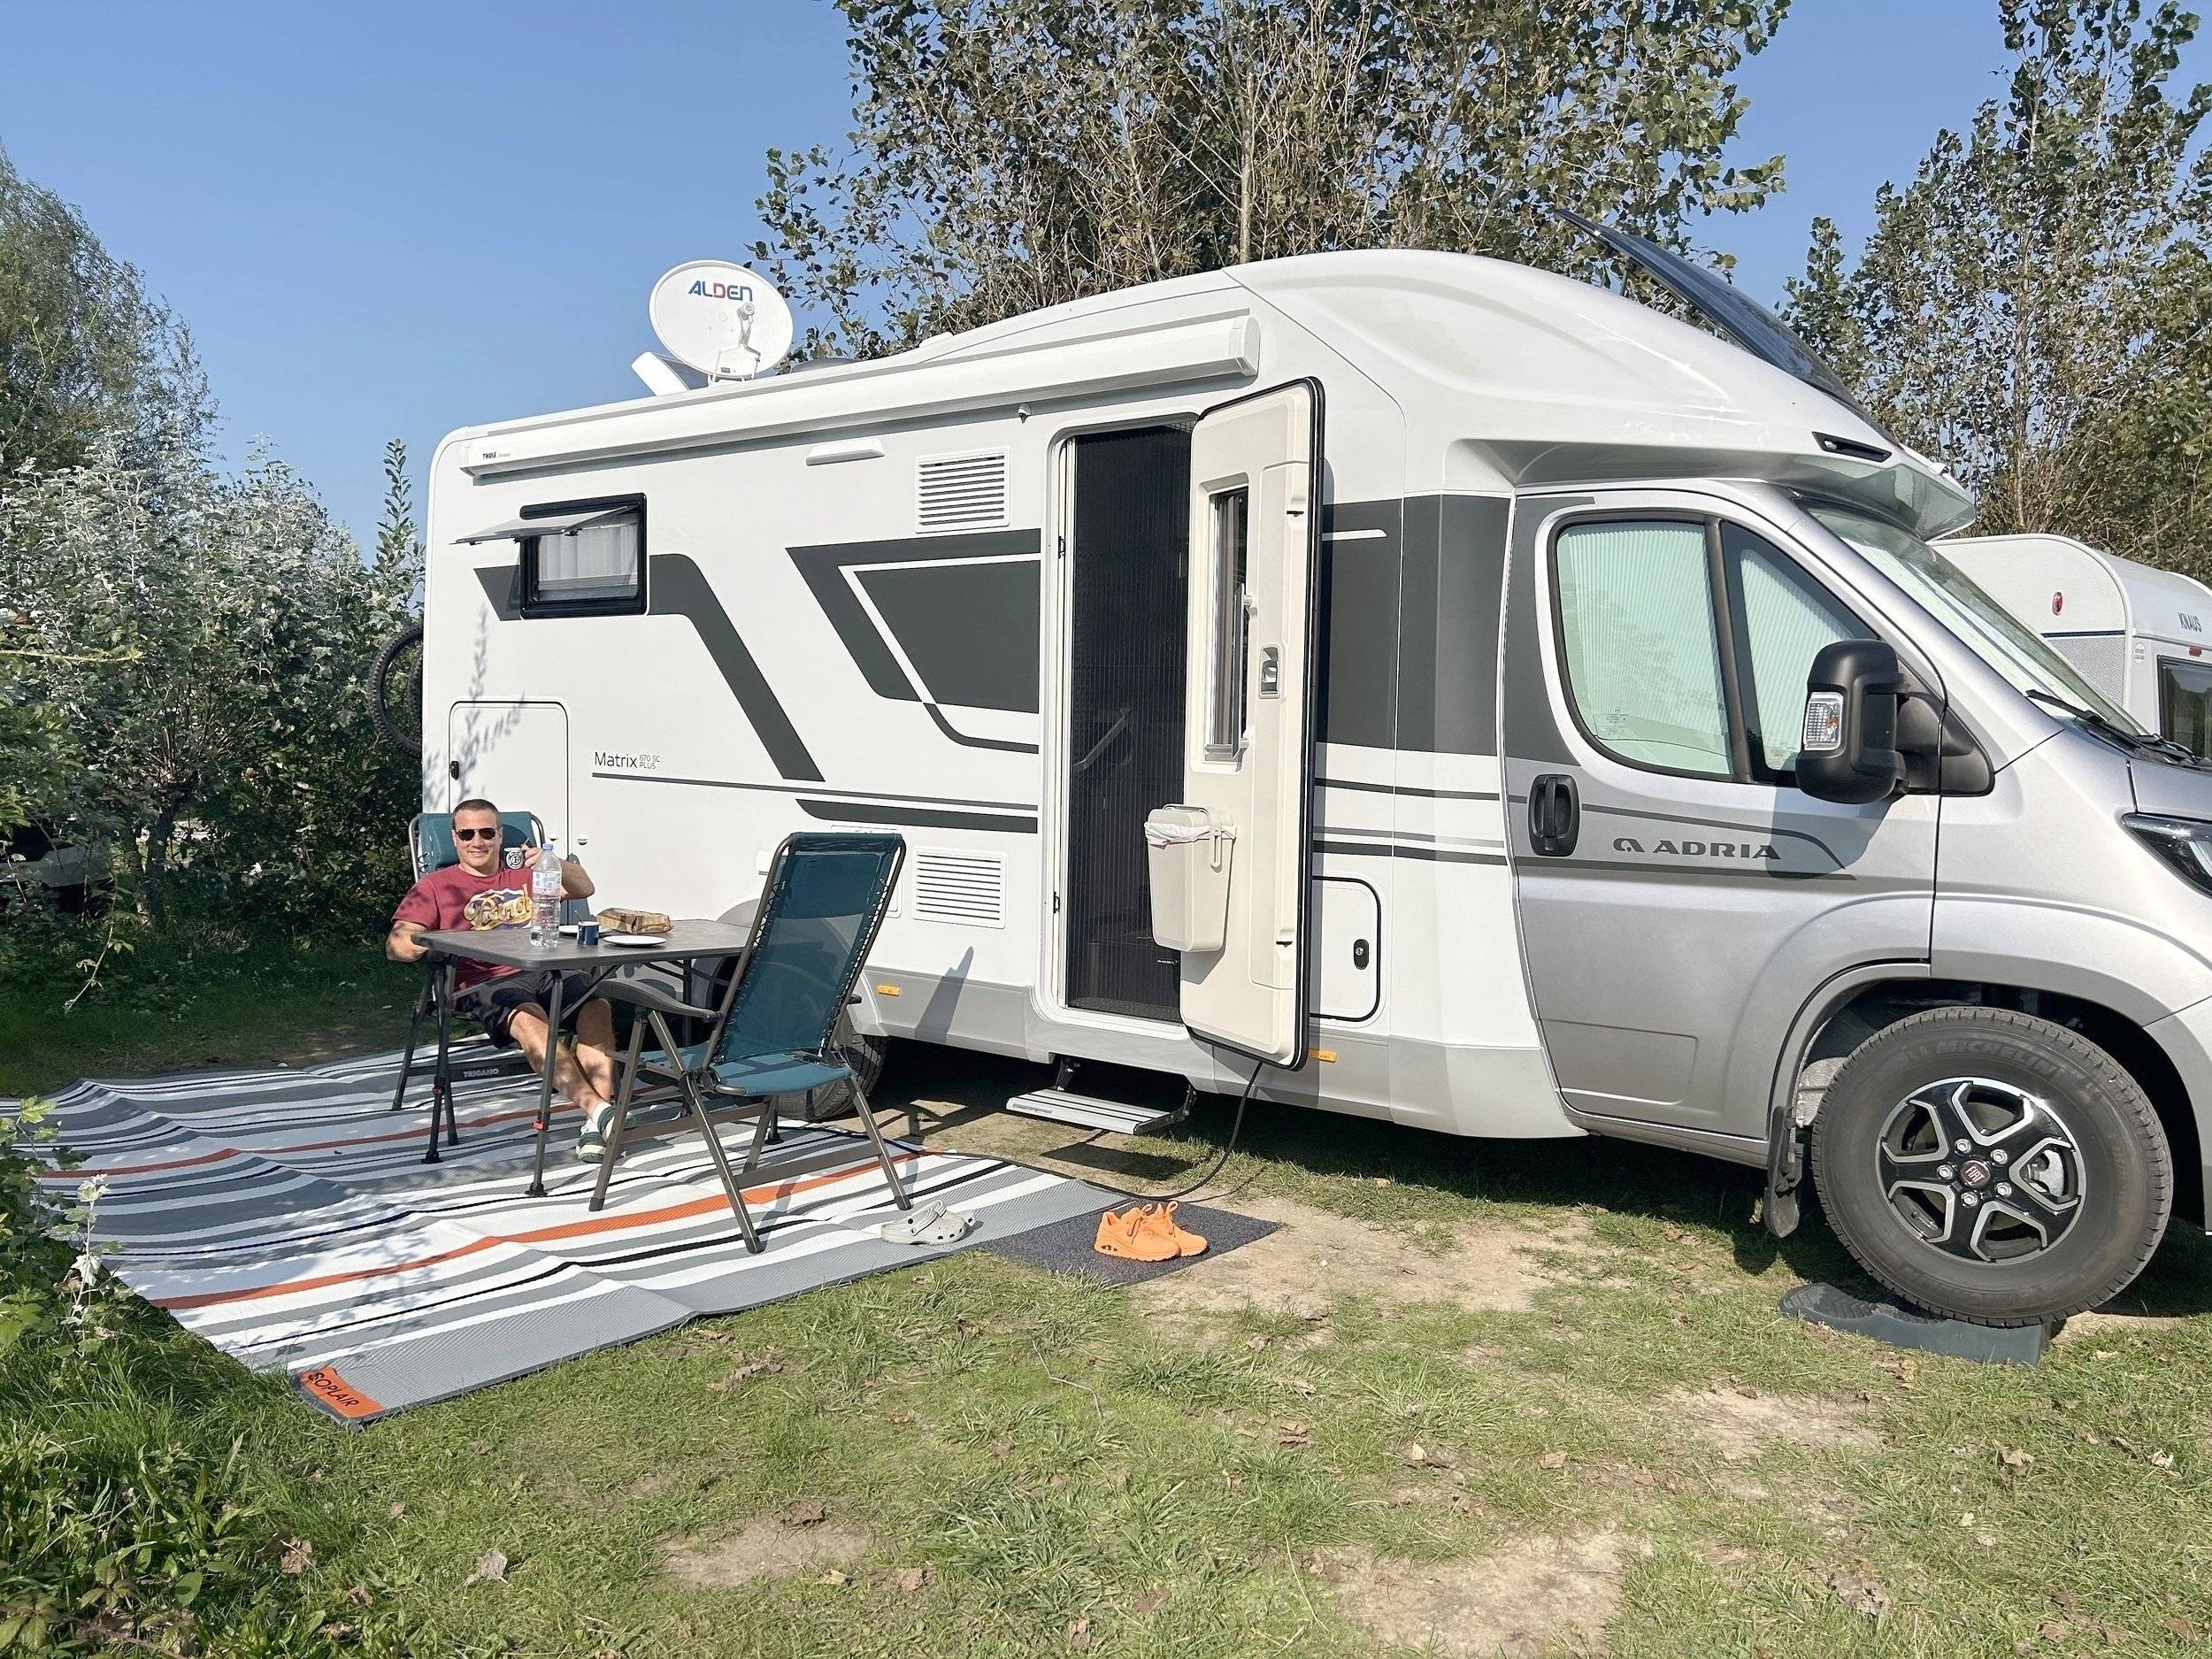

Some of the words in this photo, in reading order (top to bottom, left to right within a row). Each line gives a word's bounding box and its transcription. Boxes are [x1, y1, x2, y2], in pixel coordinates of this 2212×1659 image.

[687, 280, 753, 302] ALDEN
[2177, 611, 2202, 633] KNAUS
[595, 751, 638, 768] Matrix
[1653, 840, 1781, 860] ADRIA
[463, 1068, 499, 1078] TRIGANO
[1965, 1165, 1985, 1183] FIAT
